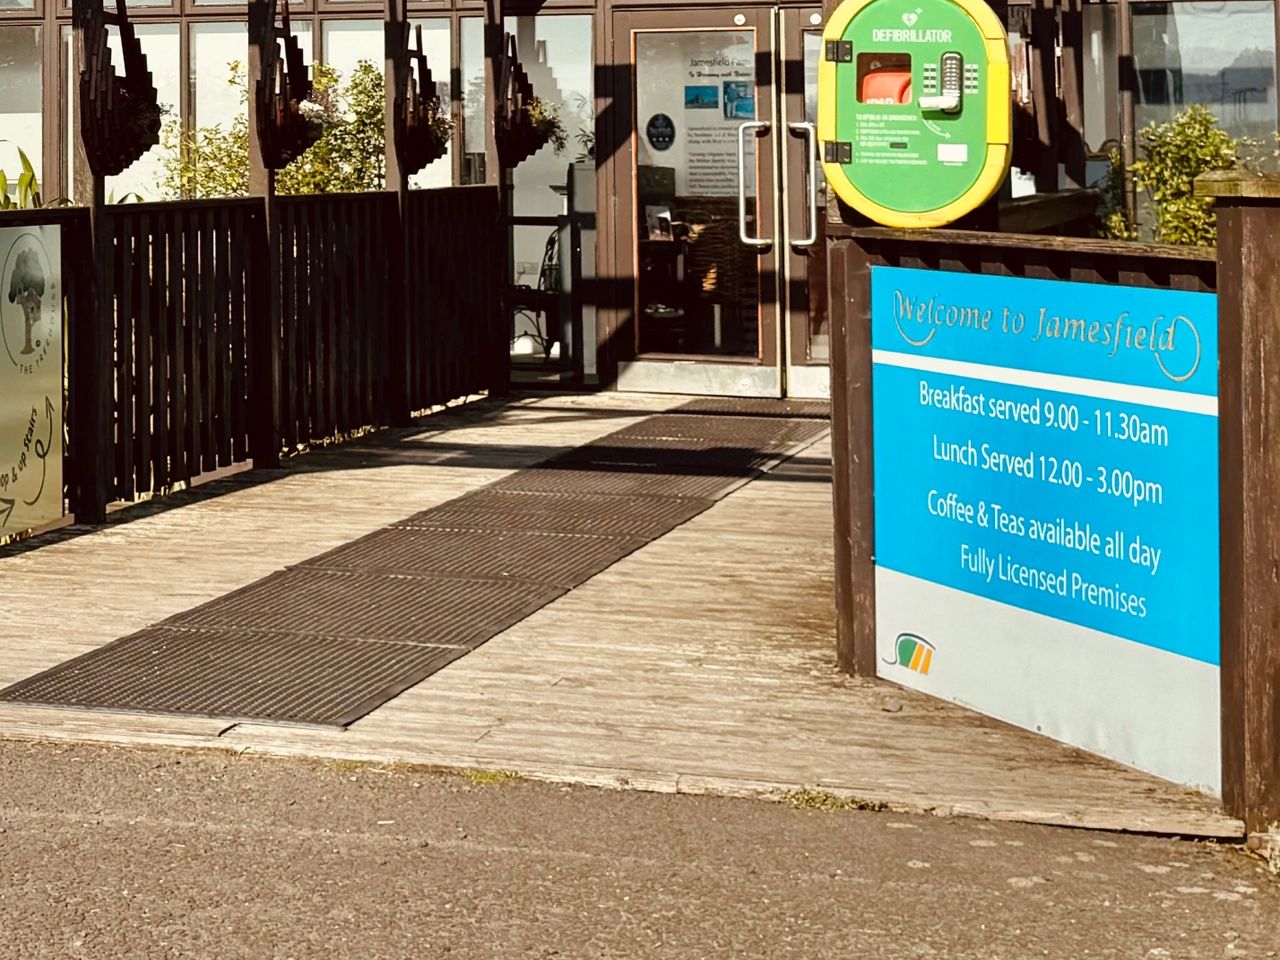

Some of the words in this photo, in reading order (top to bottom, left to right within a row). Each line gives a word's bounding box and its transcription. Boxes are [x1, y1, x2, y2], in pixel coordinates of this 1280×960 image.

[872, 28, 952, 43] DEFIBRILLATOR
[893, 289, 992, 346] Welcome
[1001, 307, 1026, 334] to
[1031, 306, 1201, 382] Jamesfield
[919, 380, 985, 416] Breakfast
[988, 398, 1040, 425] served
[1044, 400, 1079, 432] 9.00
[1094, 409, 1168, 447] 11.30am
[12, 466, 18, 483] &
[18, 451, 27, 471] up
[933, 434, 978, 467] Lunch
[981, 443, 1034, 478] Served
[1039, 455, 1083, 488] 12.00
[1097, 466, 1163, 507] 3.00pm
[927, 489, 974, 524] Coffee
[977, 501, 989, 528] &
[991, 503, 1025, 536] Teas
[1028, 518, 1101, 555] available
[1104, 530, 1124, 560] all
[1128, 535, 1161, 576] day
[961, 544, 995, 583] Fully
[998, 553, 1067, 597] Licensed
[1072, 572, 1147, 618] Premises
